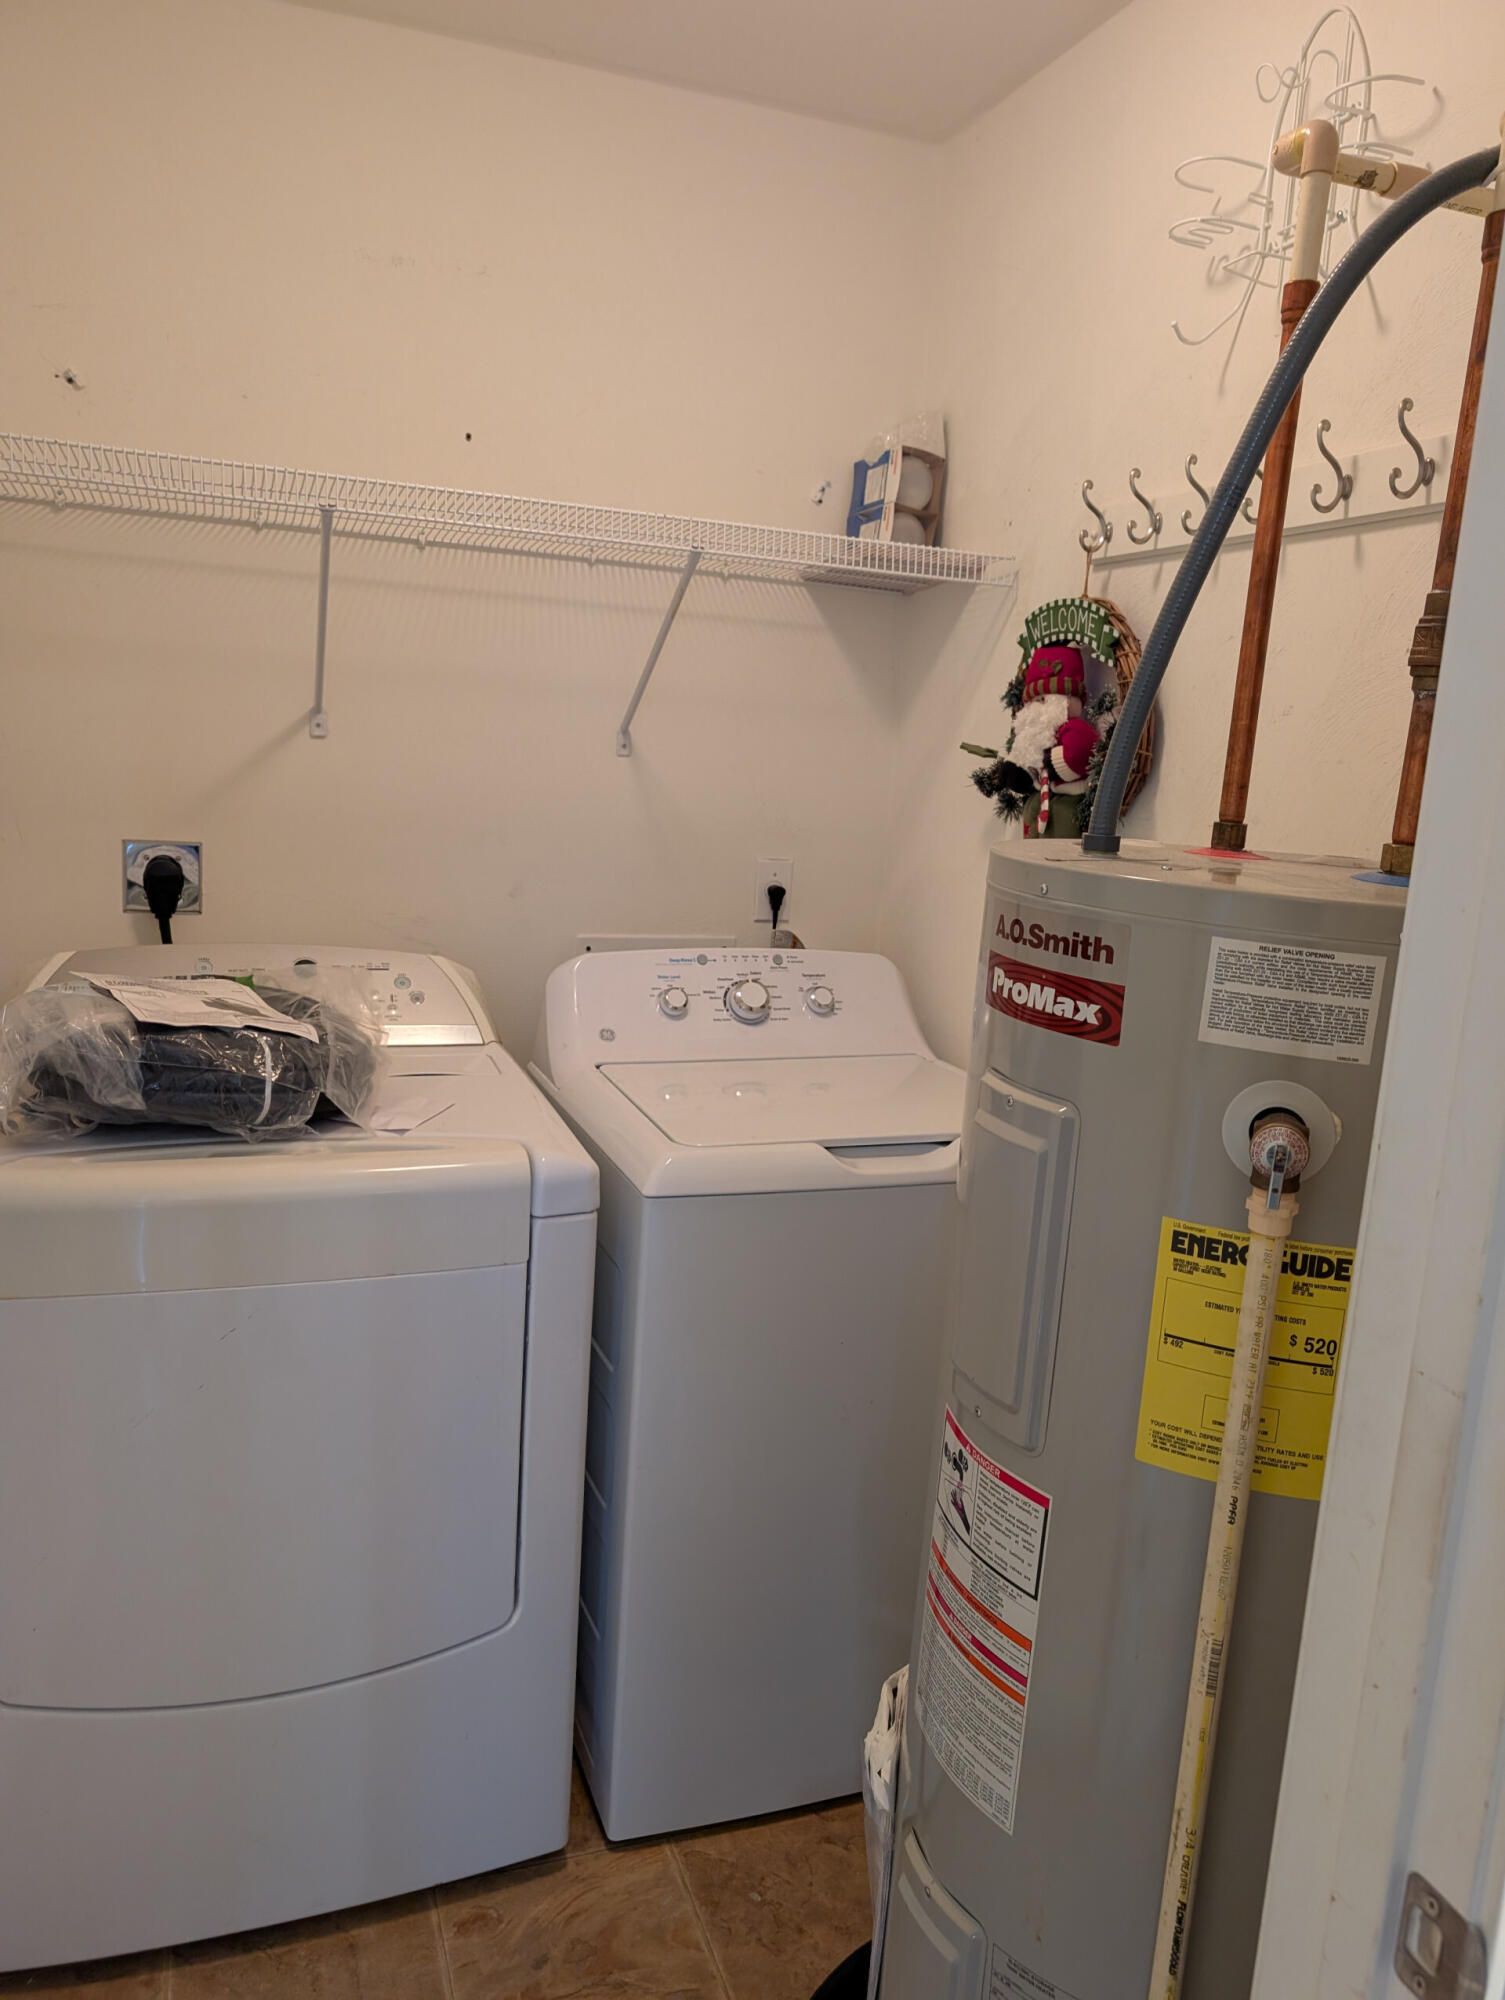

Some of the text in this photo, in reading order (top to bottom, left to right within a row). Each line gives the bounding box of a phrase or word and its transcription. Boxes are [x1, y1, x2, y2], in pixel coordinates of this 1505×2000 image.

[1029, 606, 1099, 639] WELCOME
[1259, 945, 1282, 953] RELIEF
[1305, 951, 1335, 960] OPENING
[992, 966, 1101, 1026] ProMax
[1205, 1301, 1234, 1313] ESTIMATED
[1289, 1334, 1337, 1356] $ 520
[1150, 1419, 1166, 1429] YOUR
[1167, 1424, 1182, 1433] COST
[1257, 1445, 1274, 1454] TILITY
[972, 1449, 1001, 1479] DANGER
